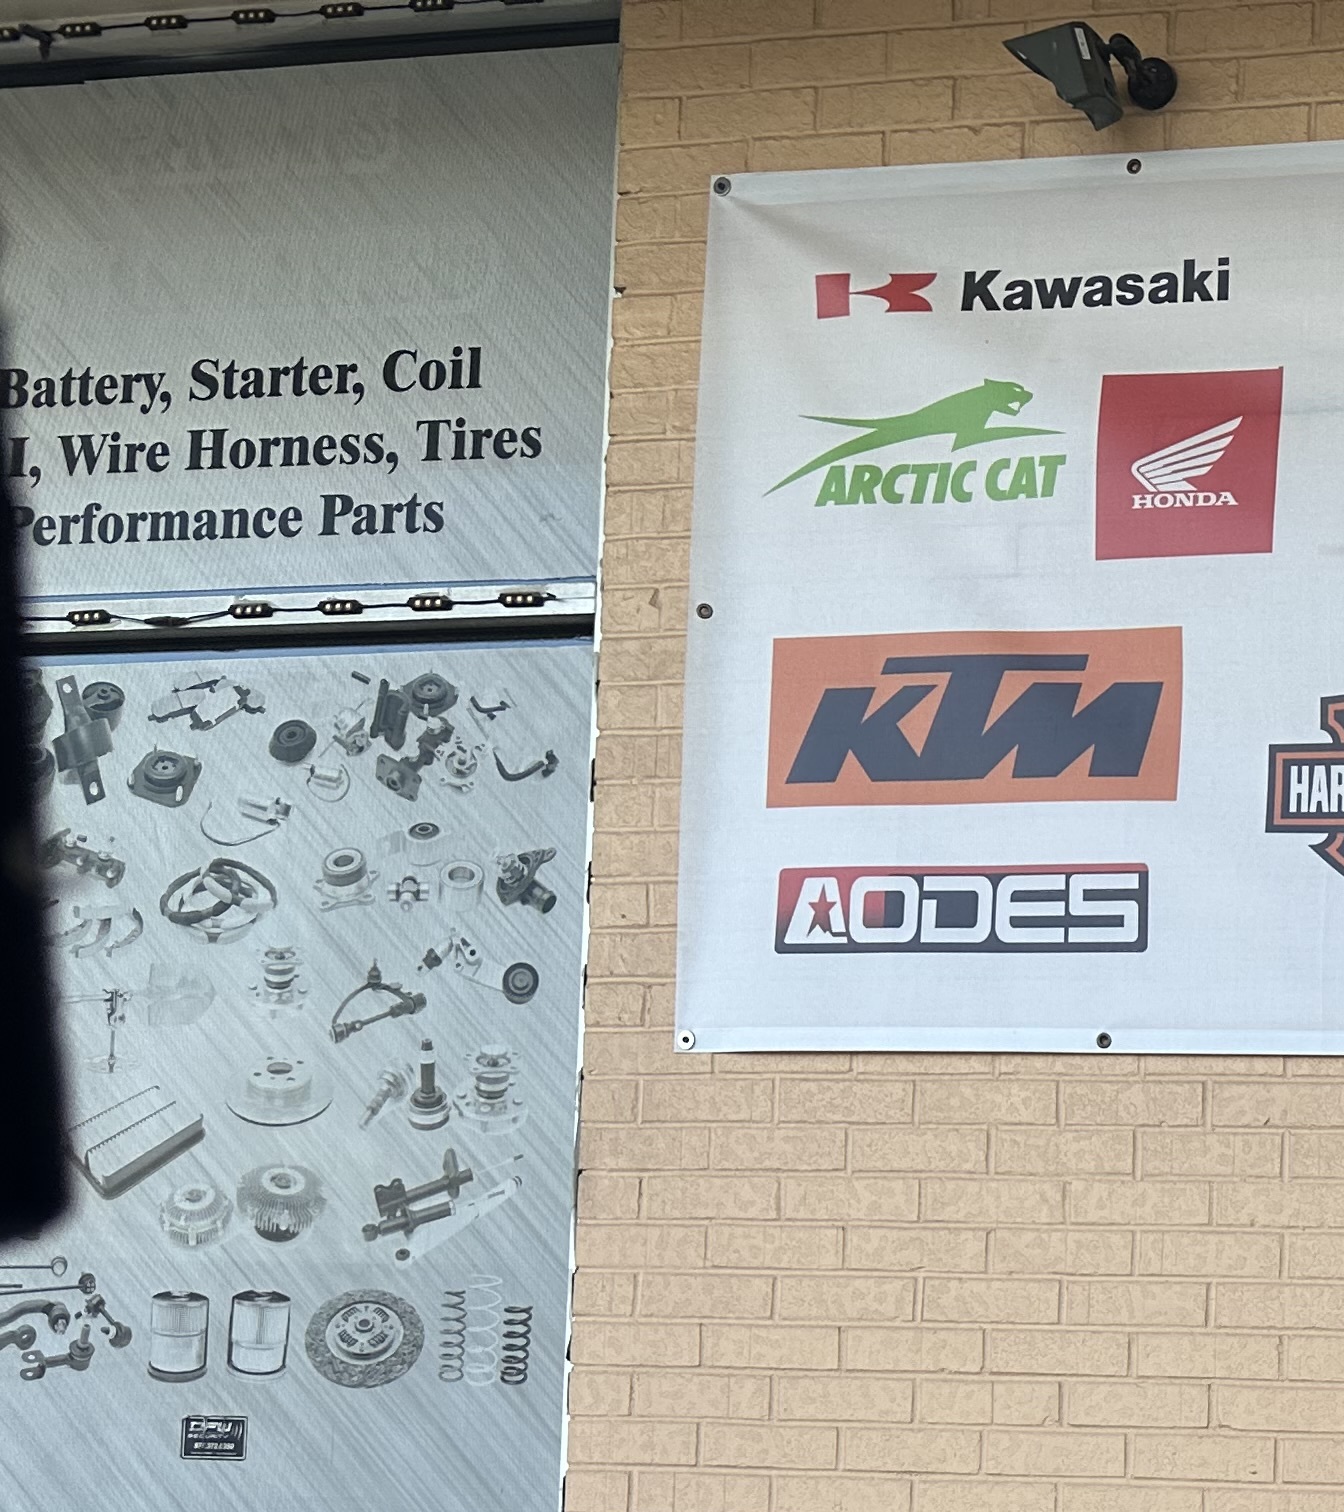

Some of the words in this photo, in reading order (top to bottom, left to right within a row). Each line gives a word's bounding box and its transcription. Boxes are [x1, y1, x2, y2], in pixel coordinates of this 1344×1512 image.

[960, 256, 1231, 313] Kawasaki
[0, 367, 171, 414] Battery,
[188, 356, 365, 403] Starter,
[383, 347, 482, 394] Coil
[58, 431, 171, 476] Wire
[185, 424, 400, 473] Horness,
[416, 417, 543, 462] Tires
[813, 459, 979, 507] ARCTIC
[985, 454, 1067, 501] CAT
[1131, 490, 1239, 511] HONDA
[11, 502, 303, 546] Performance
[319, 492, 446, 536] Parts
[784, 653, 1164, 785] KTM
[783, 873, 1140, 944] AODES
